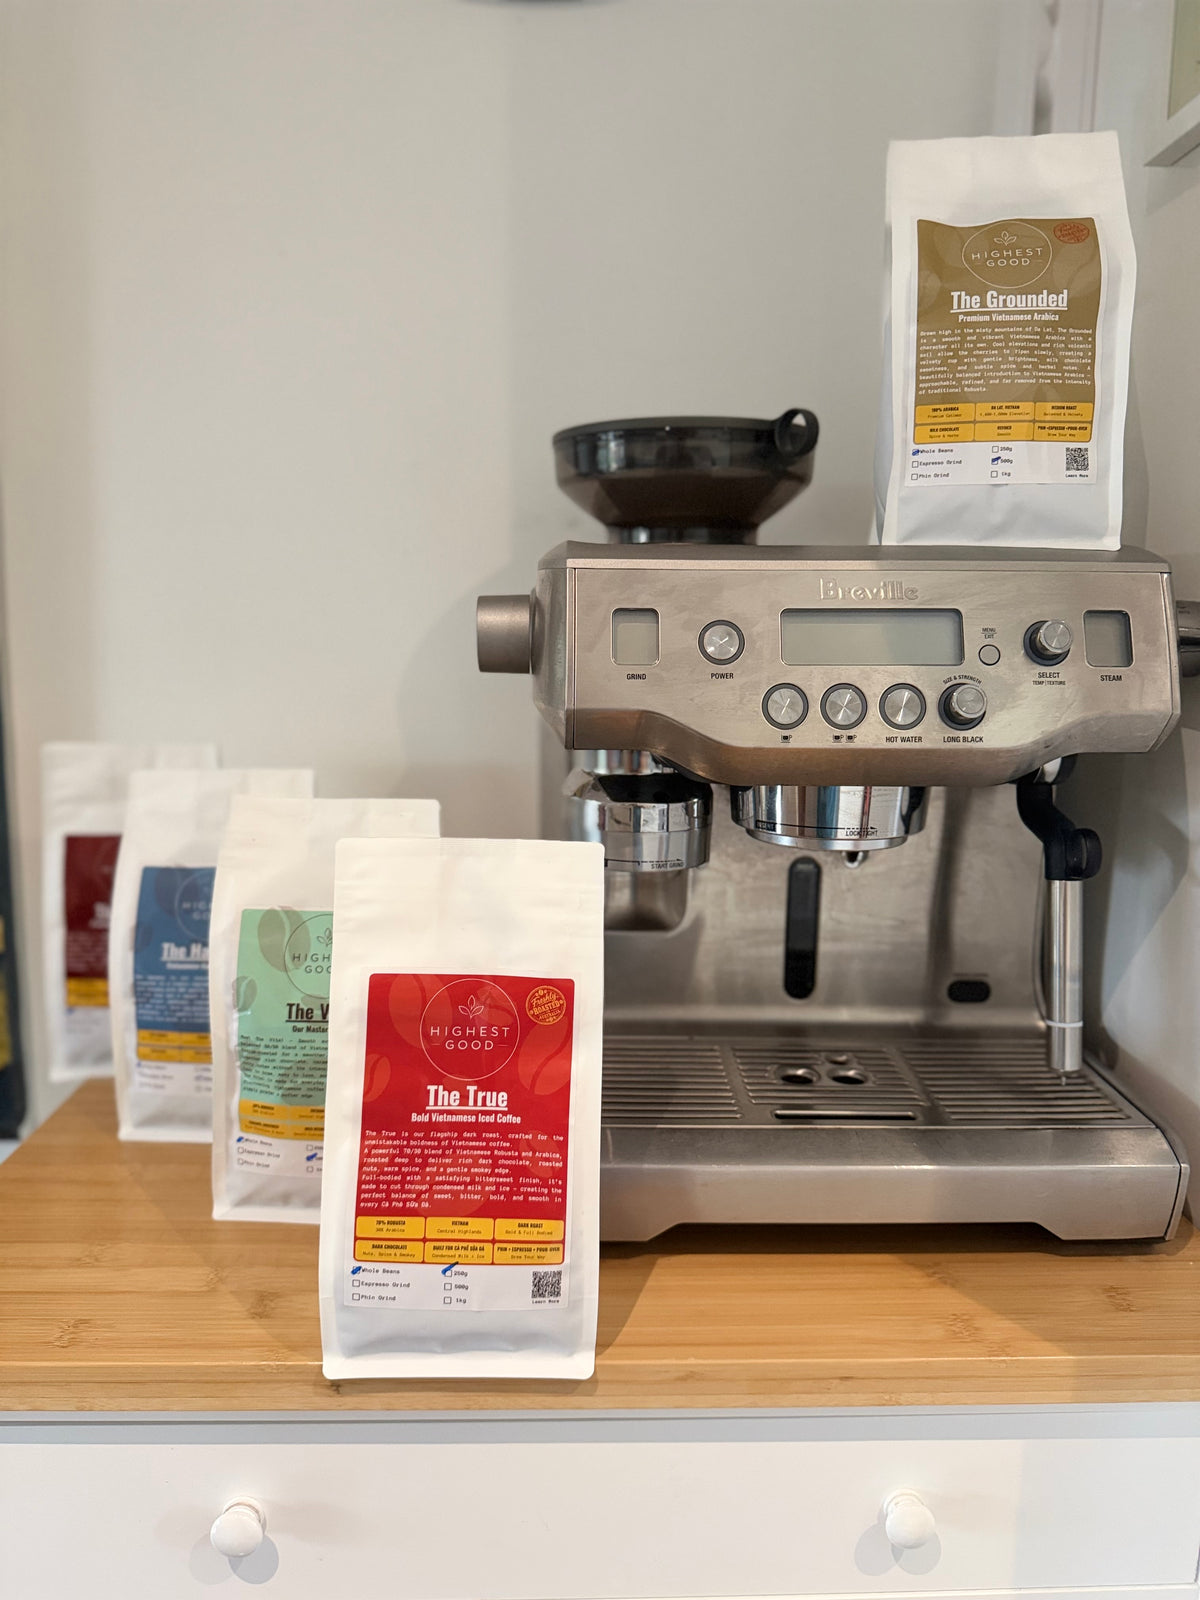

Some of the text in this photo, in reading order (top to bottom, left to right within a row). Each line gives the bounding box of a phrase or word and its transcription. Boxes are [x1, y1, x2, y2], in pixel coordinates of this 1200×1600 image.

[972, 248, 1043, 260] HIGHEST
[986, 258, 1030, 267] GOOD
[951, 290, 1068, 309] The Grounded
[959, 314, 989, 322] Premium
[992, 313, 1031, 321] Vietnamese
[819, 578, 918, 600] Breville
[943, 675, 953, 684] SIZE
[958, 675, 981, 684] STRENGTH
[292, 953, 330, 962] HIGH
[286, 1003, 314, 1020] The
[534, 1001, 560, 1015] ROASTED
[430, 1026, 510, 1037] HIGHEST
[445, 1040, 494, 1050] GOOD
[427, 1085, 507, 1106] The True
[411, 1113, 521, 1124] Bold Vietnamese Iced Coffee
[520, 1186, 548, 1194] creating
